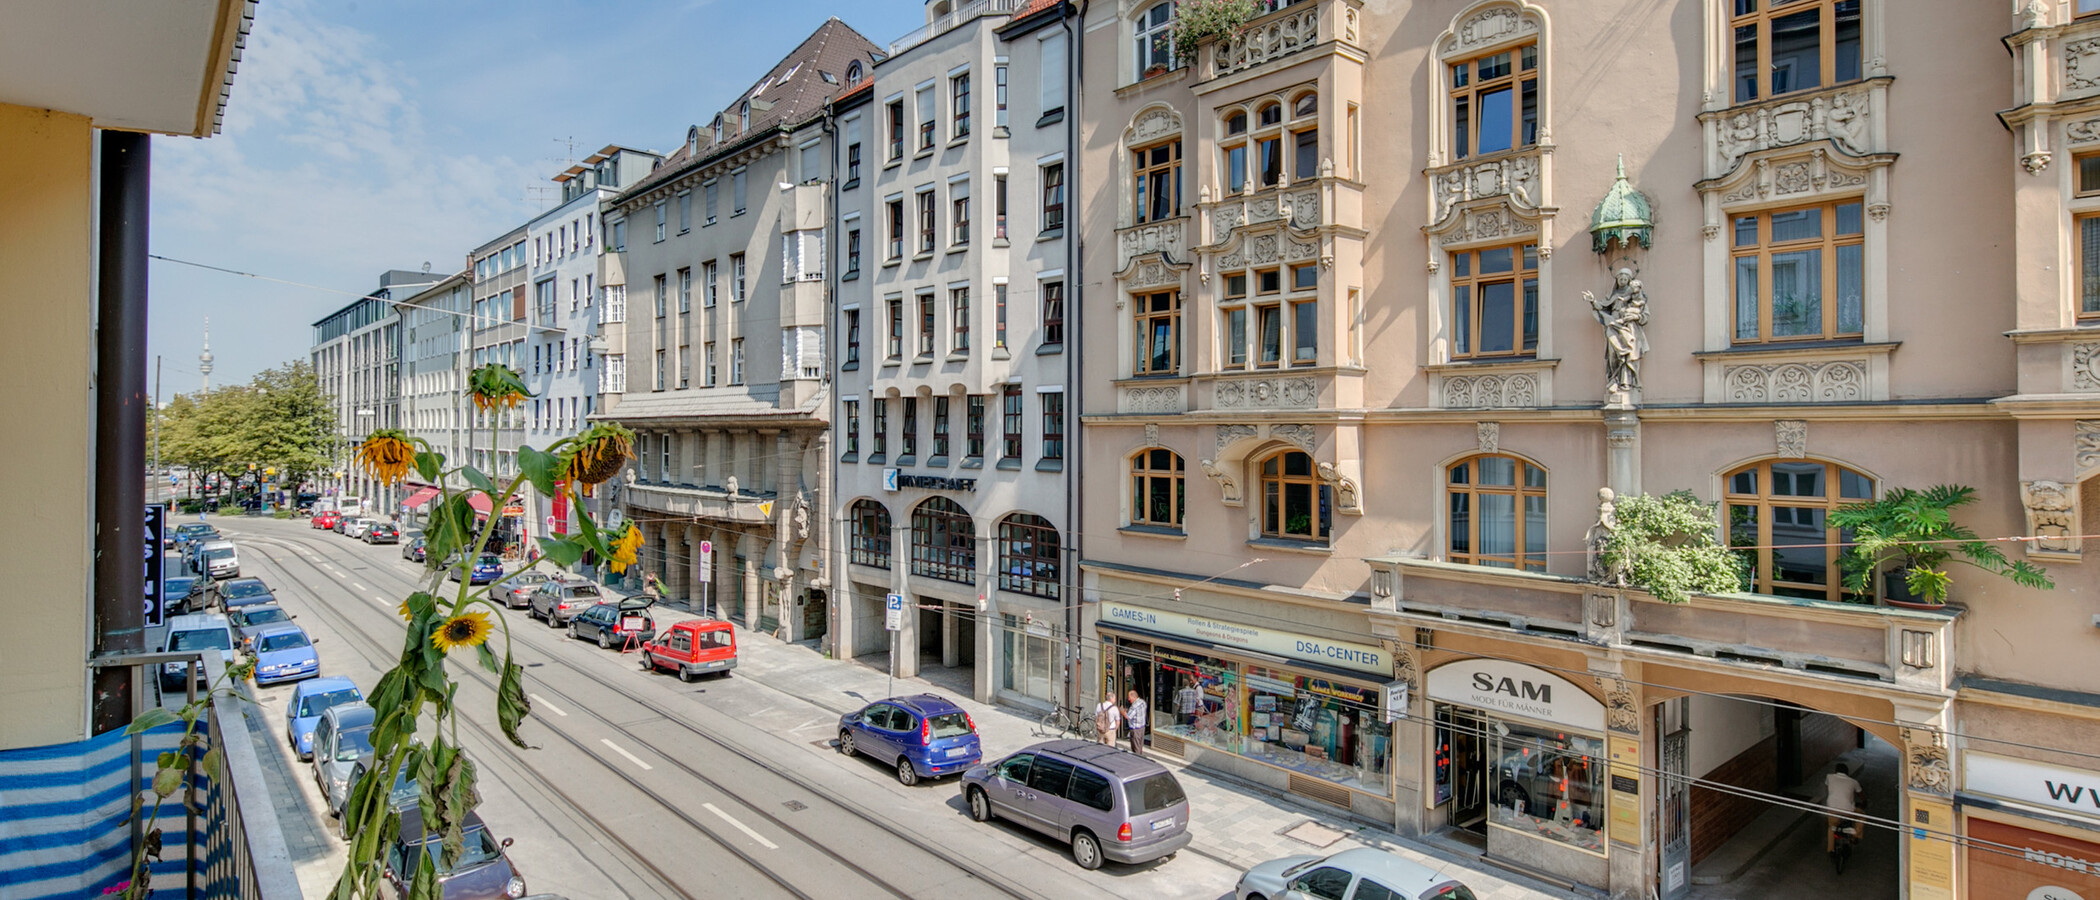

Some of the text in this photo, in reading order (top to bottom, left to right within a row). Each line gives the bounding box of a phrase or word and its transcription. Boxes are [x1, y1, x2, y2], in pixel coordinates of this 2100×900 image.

[1111, 607, 1156, 624] GAMES-IN
[1187, 617, 1206, 627] Rollen
[1212, 622, 1259, 637] Strategiespiele
[1195, 628, 1221, 639] Dungeons
[1226, 634, 1249, 644] Dragons
[1296, 640, 1379, 666] DSA-CENTER
[1472, 672, 1551, 703] SAM
[1471, 694, 1553, 717] MODE FÜR MÄNNER
